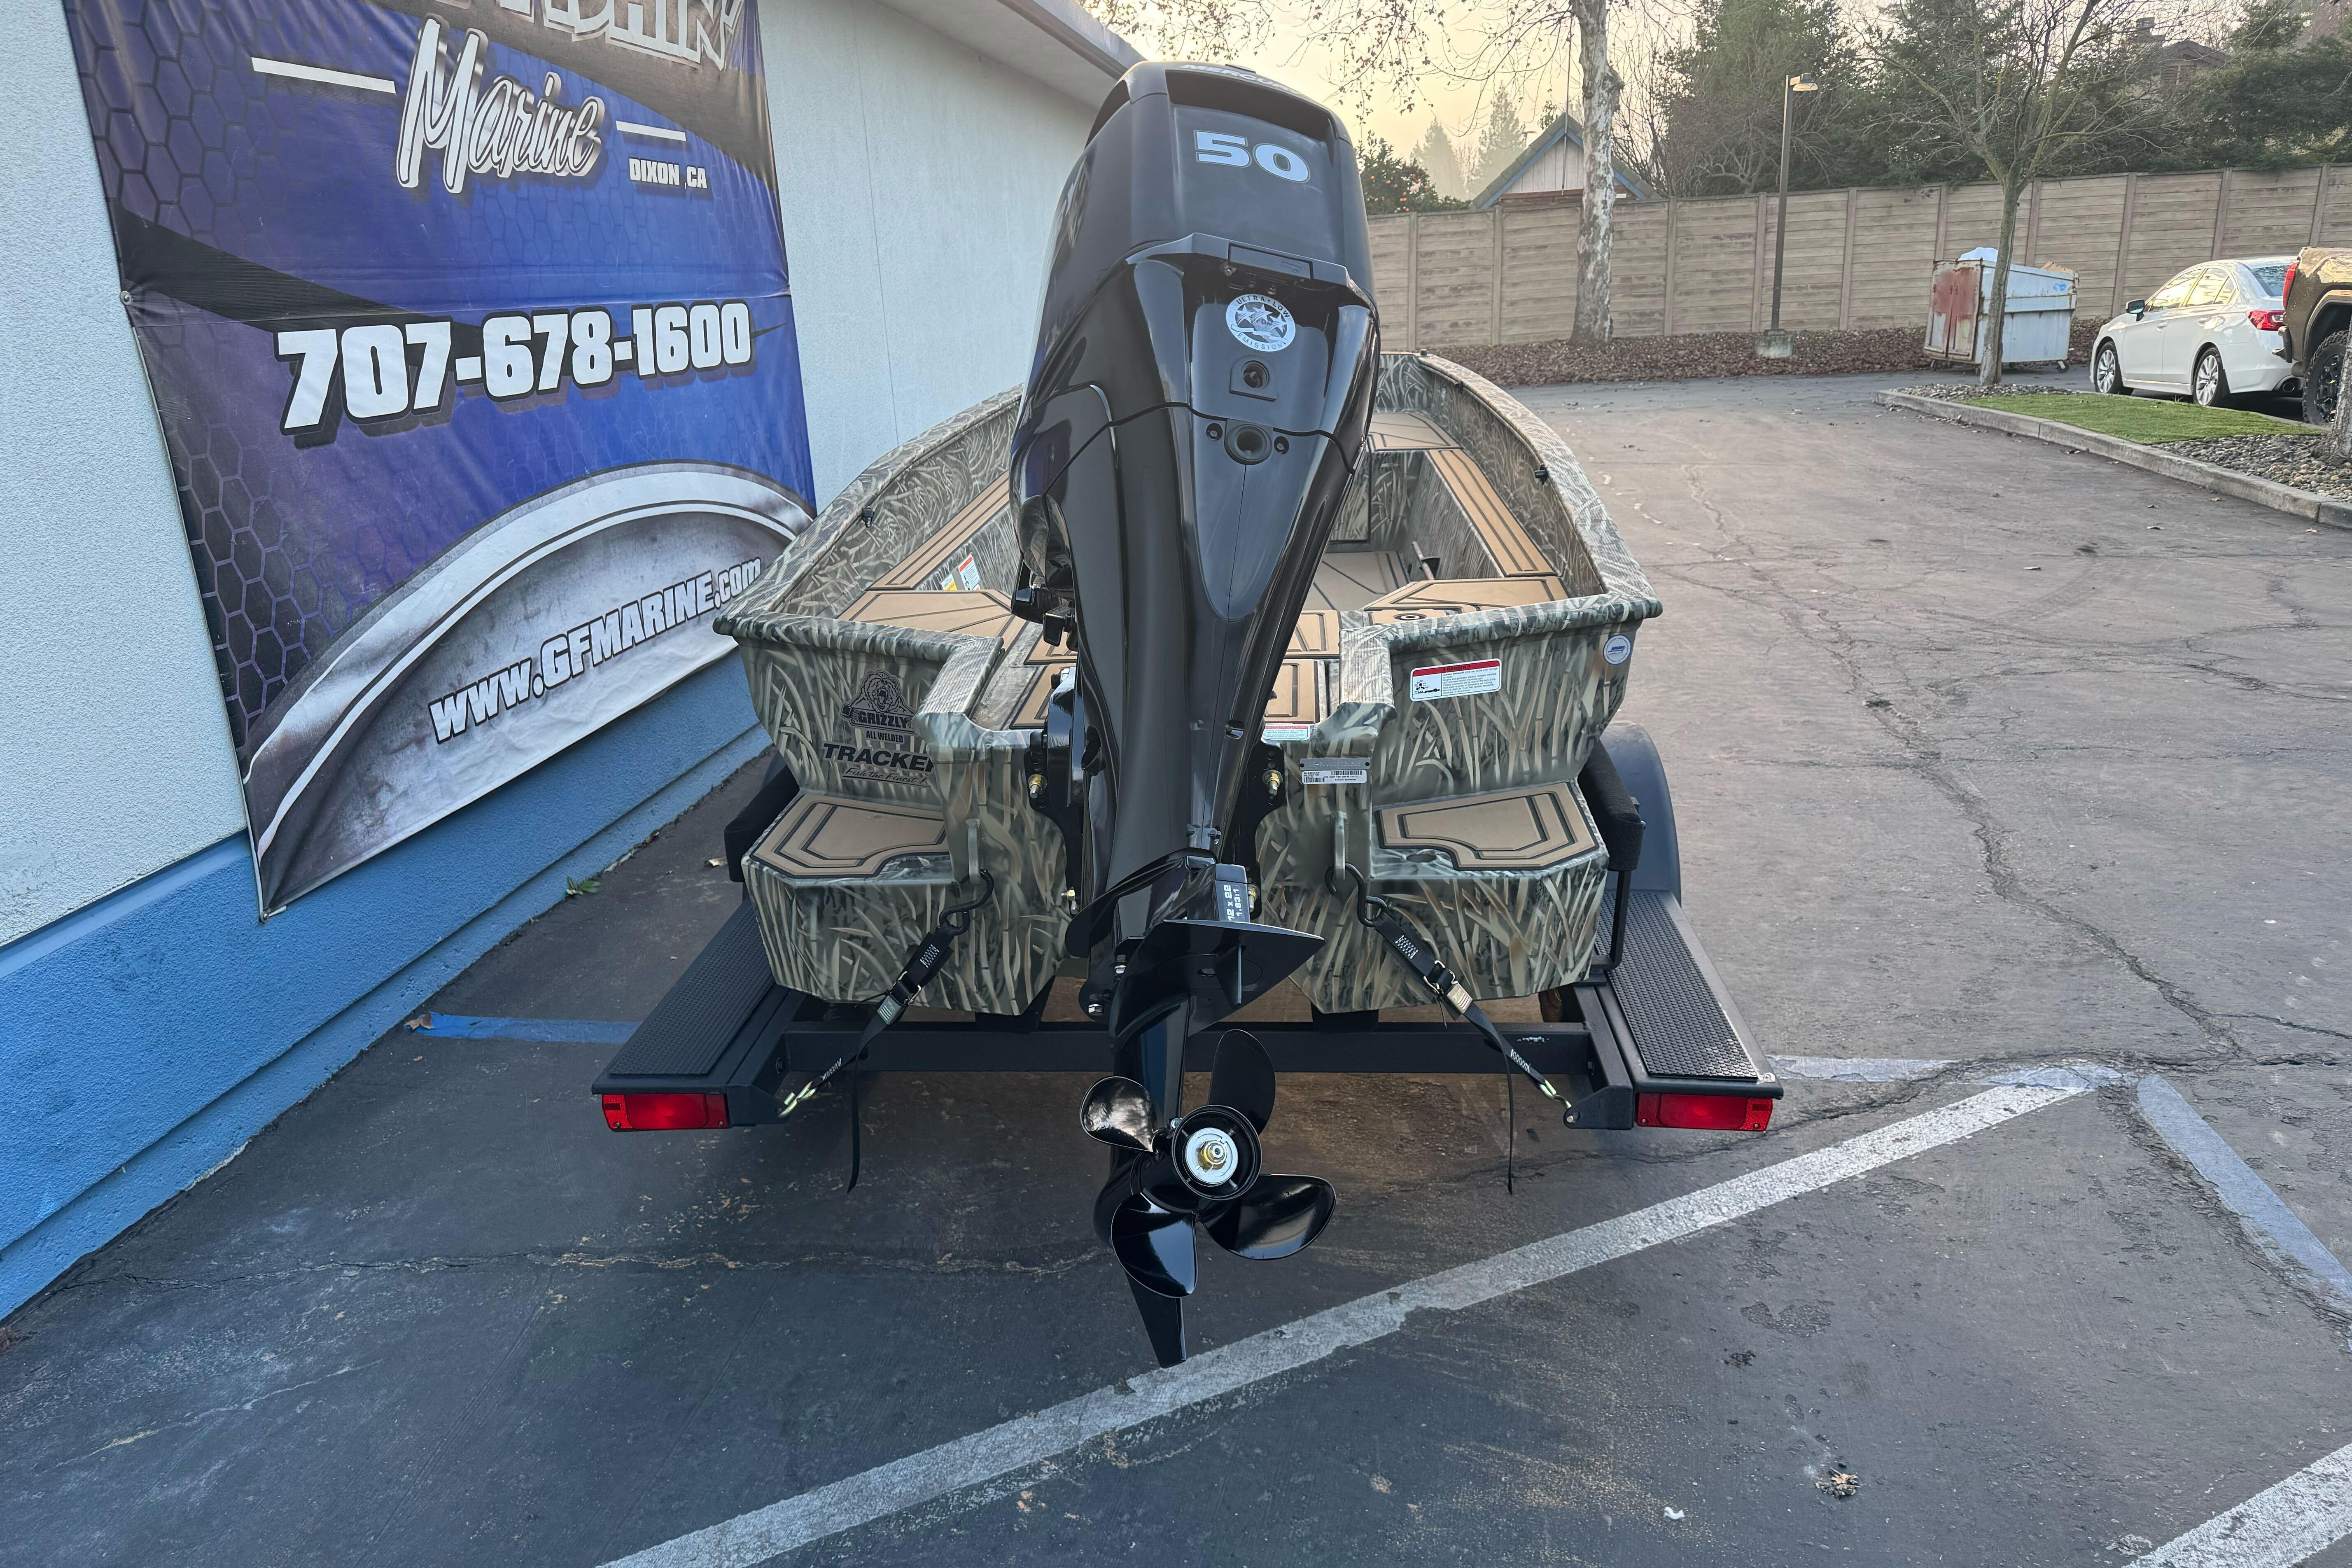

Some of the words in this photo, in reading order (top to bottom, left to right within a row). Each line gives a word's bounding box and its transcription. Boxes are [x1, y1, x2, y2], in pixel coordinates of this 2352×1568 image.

[396, 14, 606, 194] Marine
[1194, 130, 1310, 183] 50
[628, 158, 680, 185] DIXON
[1236, 295, 1265, 305] ULTRA
[1273, 301, 1290, 318] LOW
[1237, 333, 1283, 350] EMISSION
[275, 301, 753, 434] 707-678-1600
[858, 710, 908, 729] GRIZZLY
[866, 730, 876, 740] ALL
[877, 731, 904, 743] WELDED
[845, 768, 867, 777] Fish
[869, 771, 884, 779] the
[1223, 884, 1232, 899] 22
[1227, 909, 1235, 921] 12
